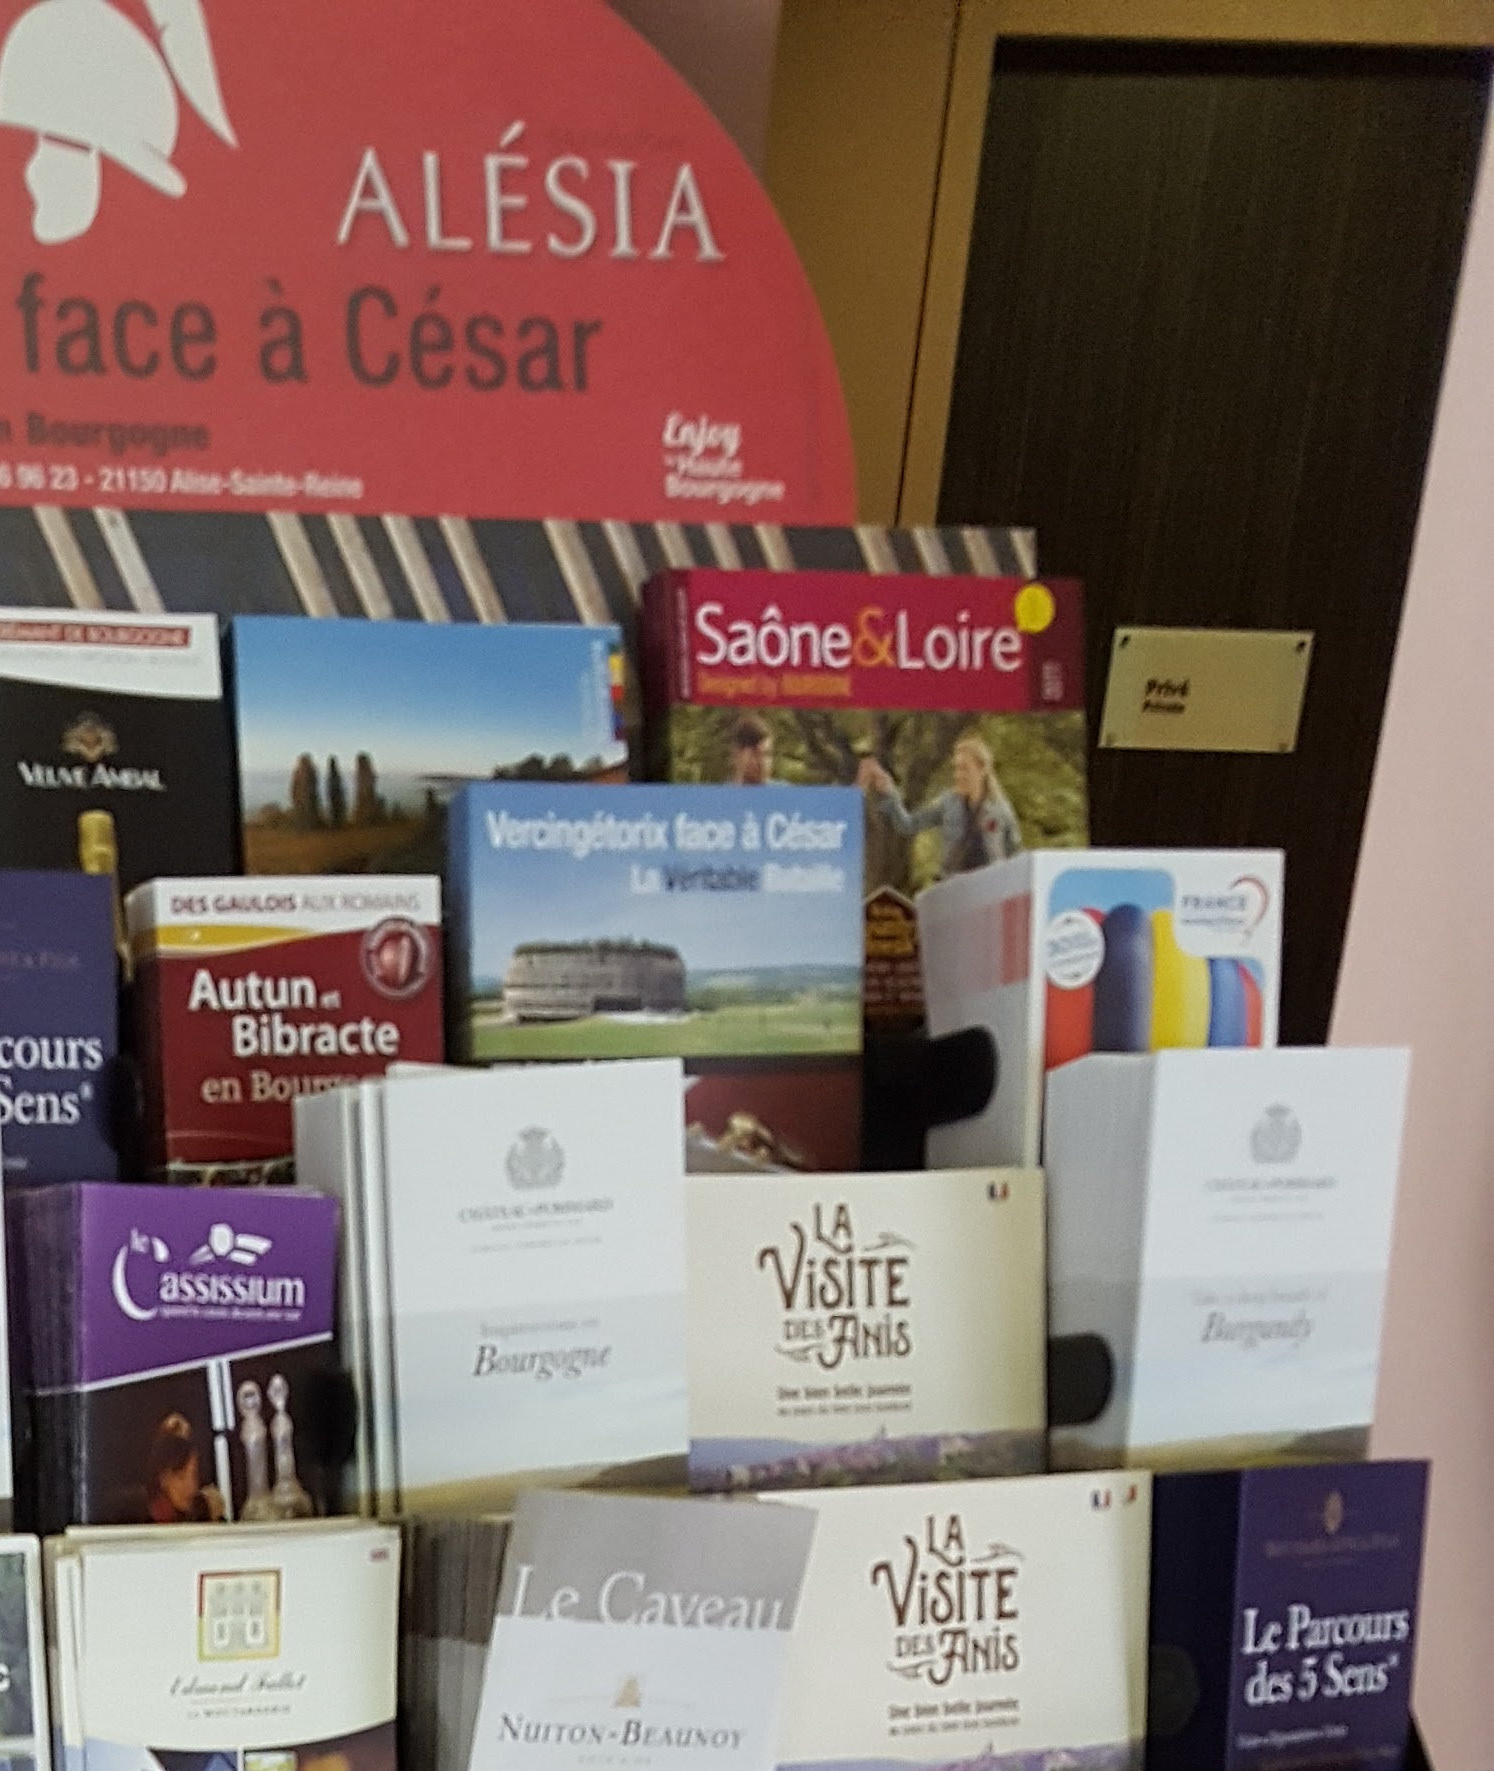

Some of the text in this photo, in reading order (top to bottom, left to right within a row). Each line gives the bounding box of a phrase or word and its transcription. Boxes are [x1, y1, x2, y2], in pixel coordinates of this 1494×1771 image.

[336, 120, 726, 263] ALÉSIA
[16, 273, 219, 382] face
[257, 279, 307, 385] à
[345, 273, 603, 392] César
[26, 412, 211, 455] Bourgogne
[486, 808, 848, 859] Vercingétorix face César
[188, 968, 317, 1012] Autun
[232, 1014, 401, 1057] Bibracte
[201, 1076, 242, 1102] en
[813, 1201, 855, 1254] LA
[783, 1318, 824, 1341] DES
[472, 1343, 612, 1382] Bourgogne
[925, 1512, 967, 1567] LA
[512, 1563, 784, 1630] Le Caveau
[894, 1634, 937, 1658] DES
[1242, 1603, 1410, 1655] Le Parcours
[1244, 1659, 1293, 1707] des
[1297, 1655, 1318, 1700] 5
[498, 1713, 746, 1750] NUITON-BEAUNOY
